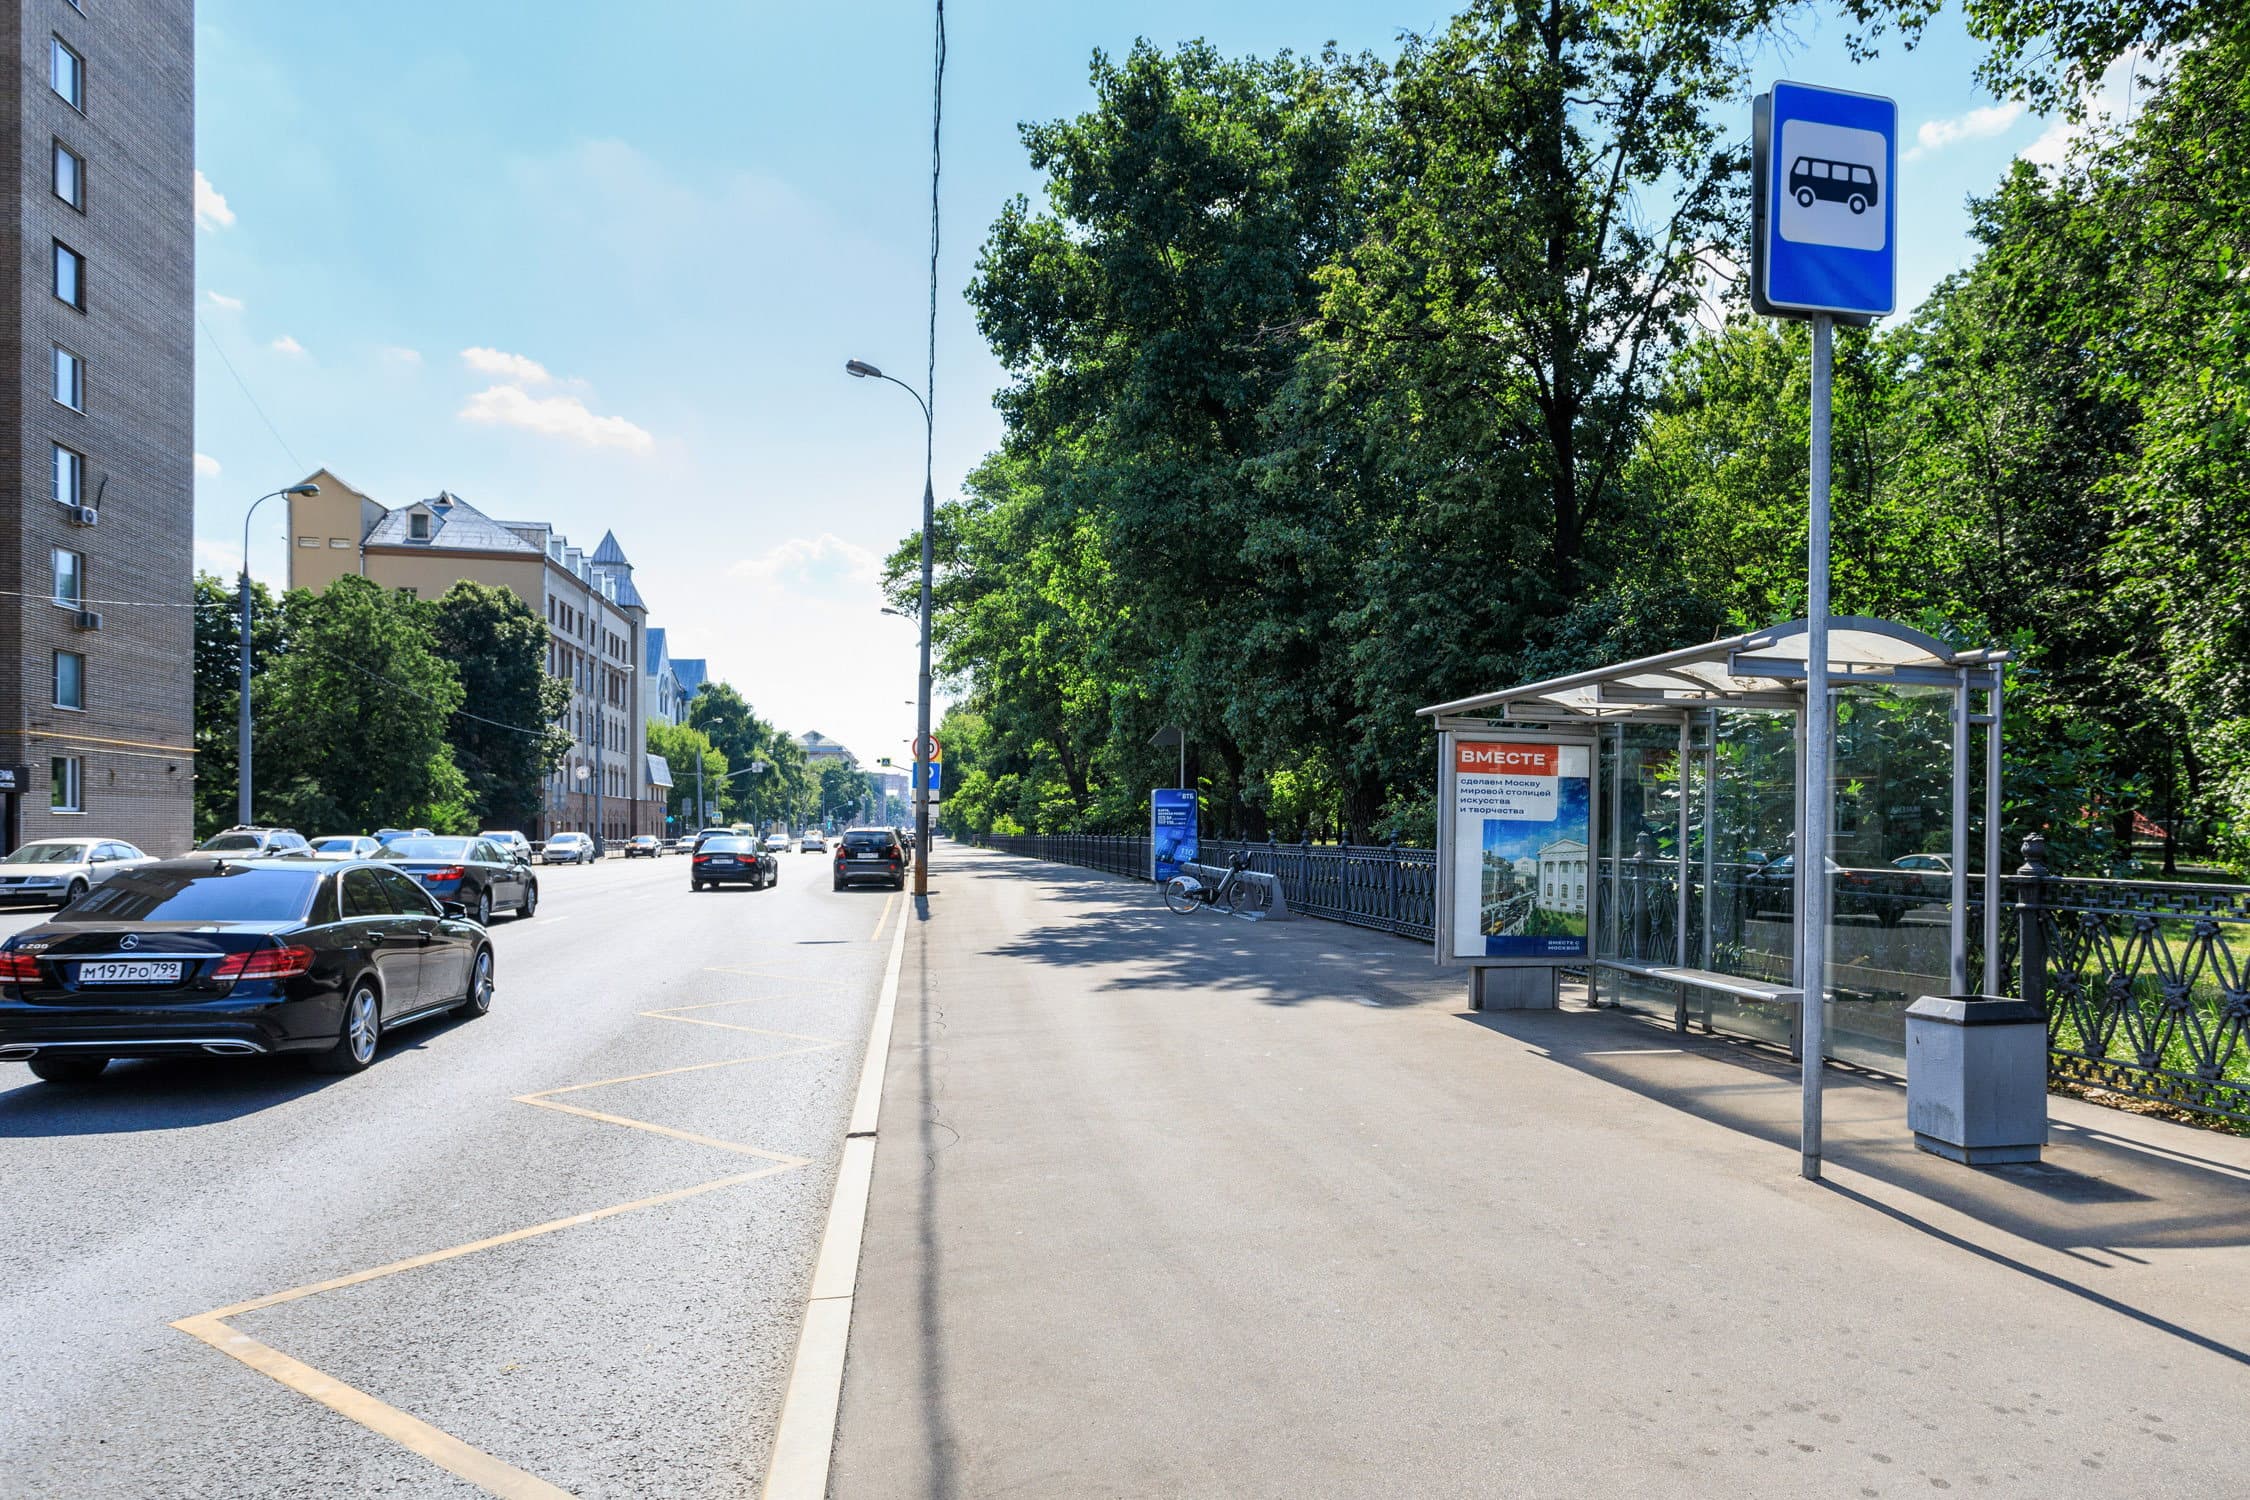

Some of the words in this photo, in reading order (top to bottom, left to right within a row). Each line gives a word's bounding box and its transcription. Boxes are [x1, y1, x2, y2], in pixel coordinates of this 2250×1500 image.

[1461, 750, 1546, 766] ВМЕСТЕ
[1460, 778, 1503, 786] сделаем
[1505, 779, 1541, 788] Москву
[1460, 787, 1504, 796] мировой
[1505, 789, 1551, 797] столицей
[1460, 797, 1510, 806] искусства
[1469, 807, 1525, 815] творчества
[84, 964, 150, 979] М197РО
[152, 963, 178, 974] 799
